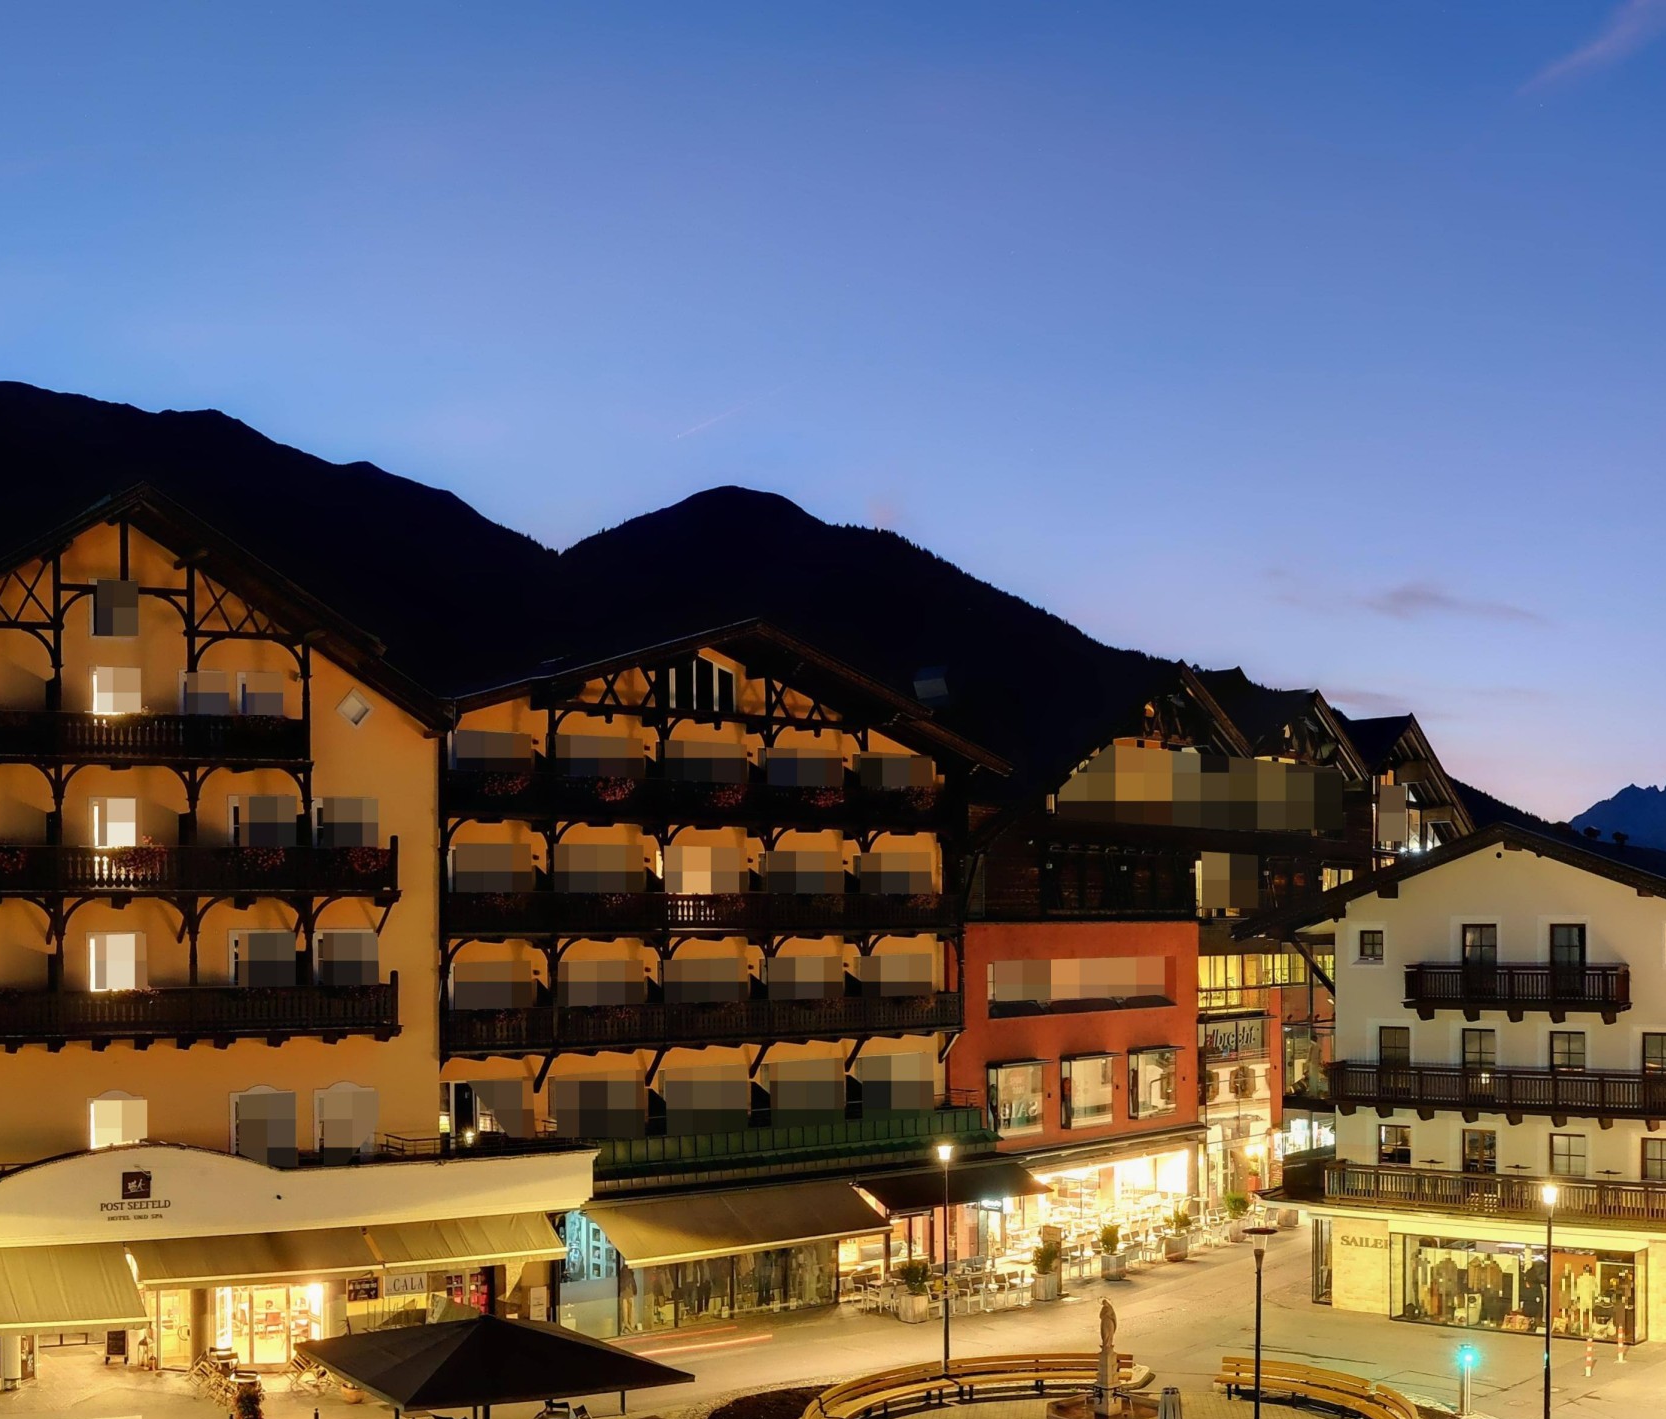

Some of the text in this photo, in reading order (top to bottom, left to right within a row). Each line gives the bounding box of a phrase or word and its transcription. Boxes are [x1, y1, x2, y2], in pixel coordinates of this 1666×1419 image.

[100, 1199, 171, 1212] POST SEEFELD
[392, 1276, 424, 1292] CALA
